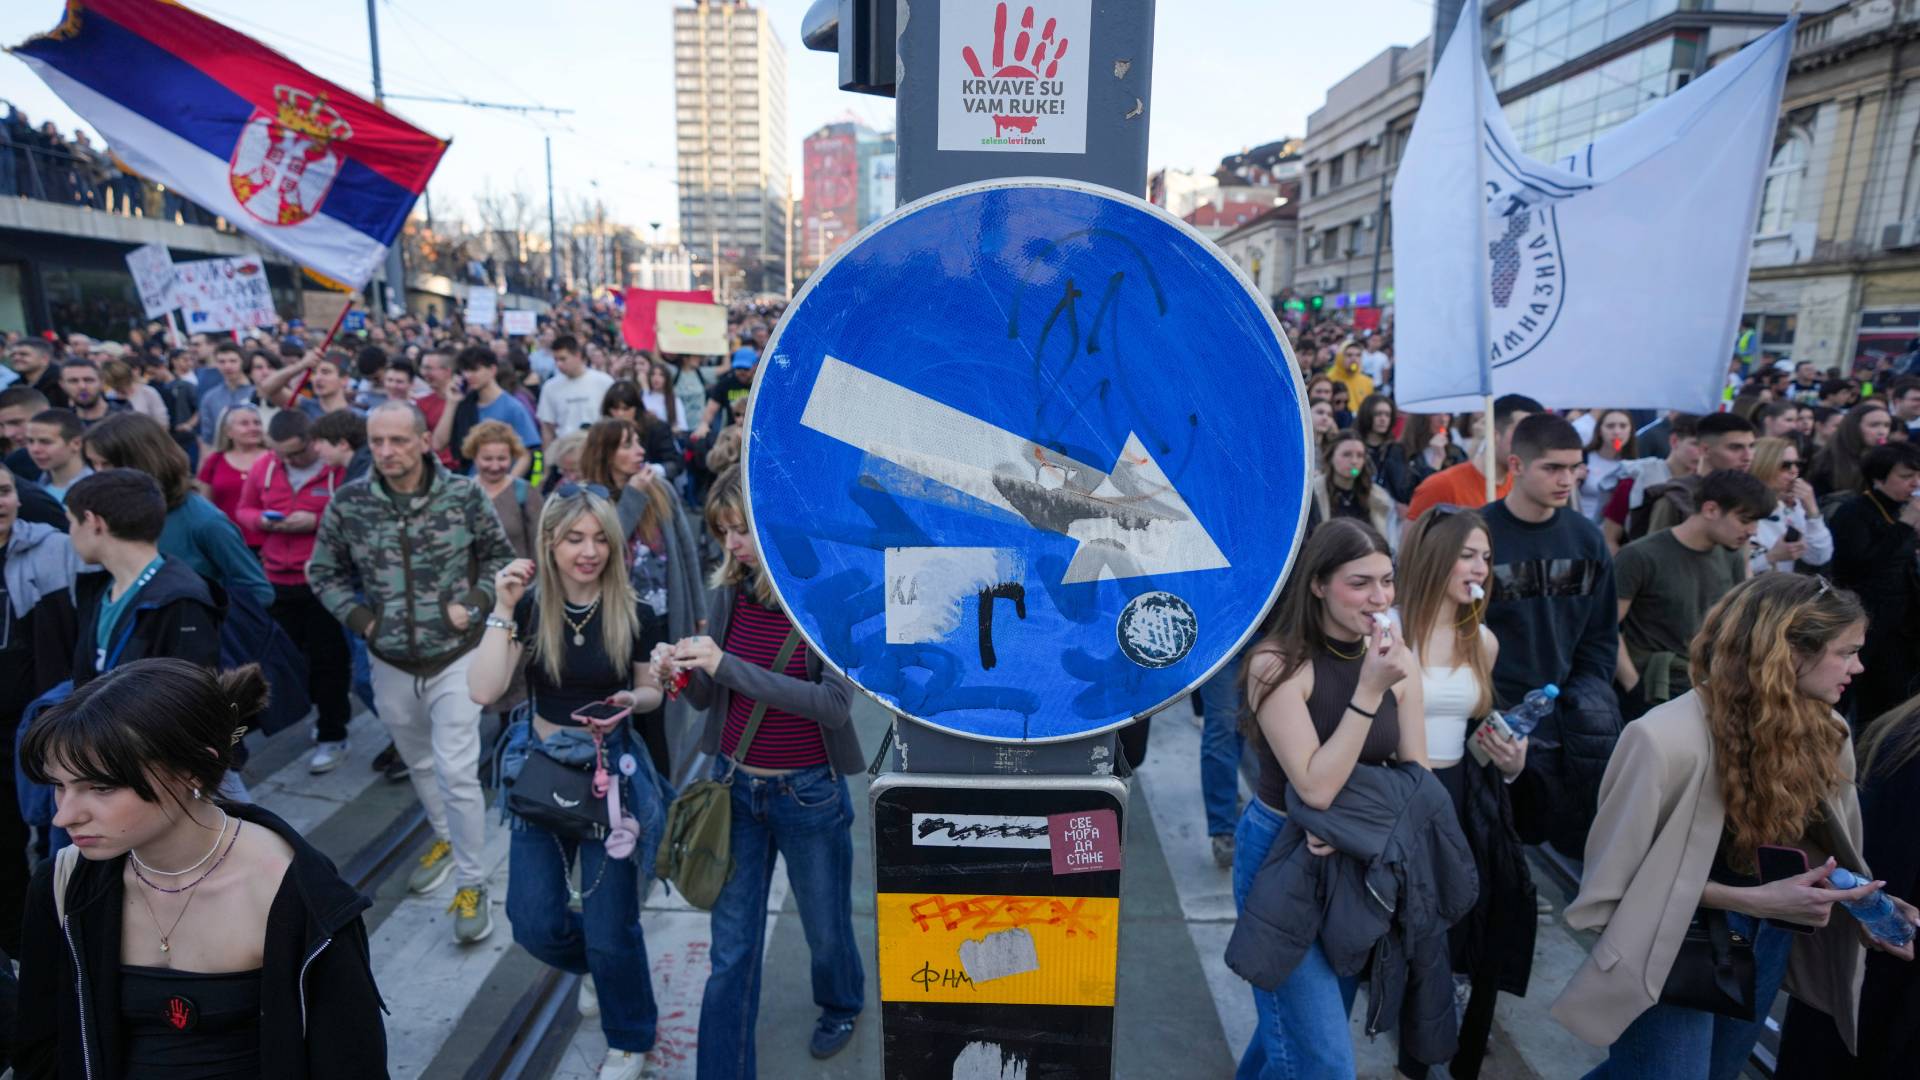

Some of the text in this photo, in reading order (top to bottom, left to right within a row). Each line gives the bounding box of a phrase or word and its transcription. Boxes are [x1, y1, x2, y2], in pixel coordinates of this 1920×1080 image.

[962, 80, 1064, 96] KRVAVE SU
[963, 98, 1065, 115] VAM RUKE!
[1069, 816, 1092, 830] СВЕ
[1064, 827, 1100, 842] МОРА
[1074, 840, 1093, 853] ДА
[1066, 851, 1104, 865] СТАНЕ
